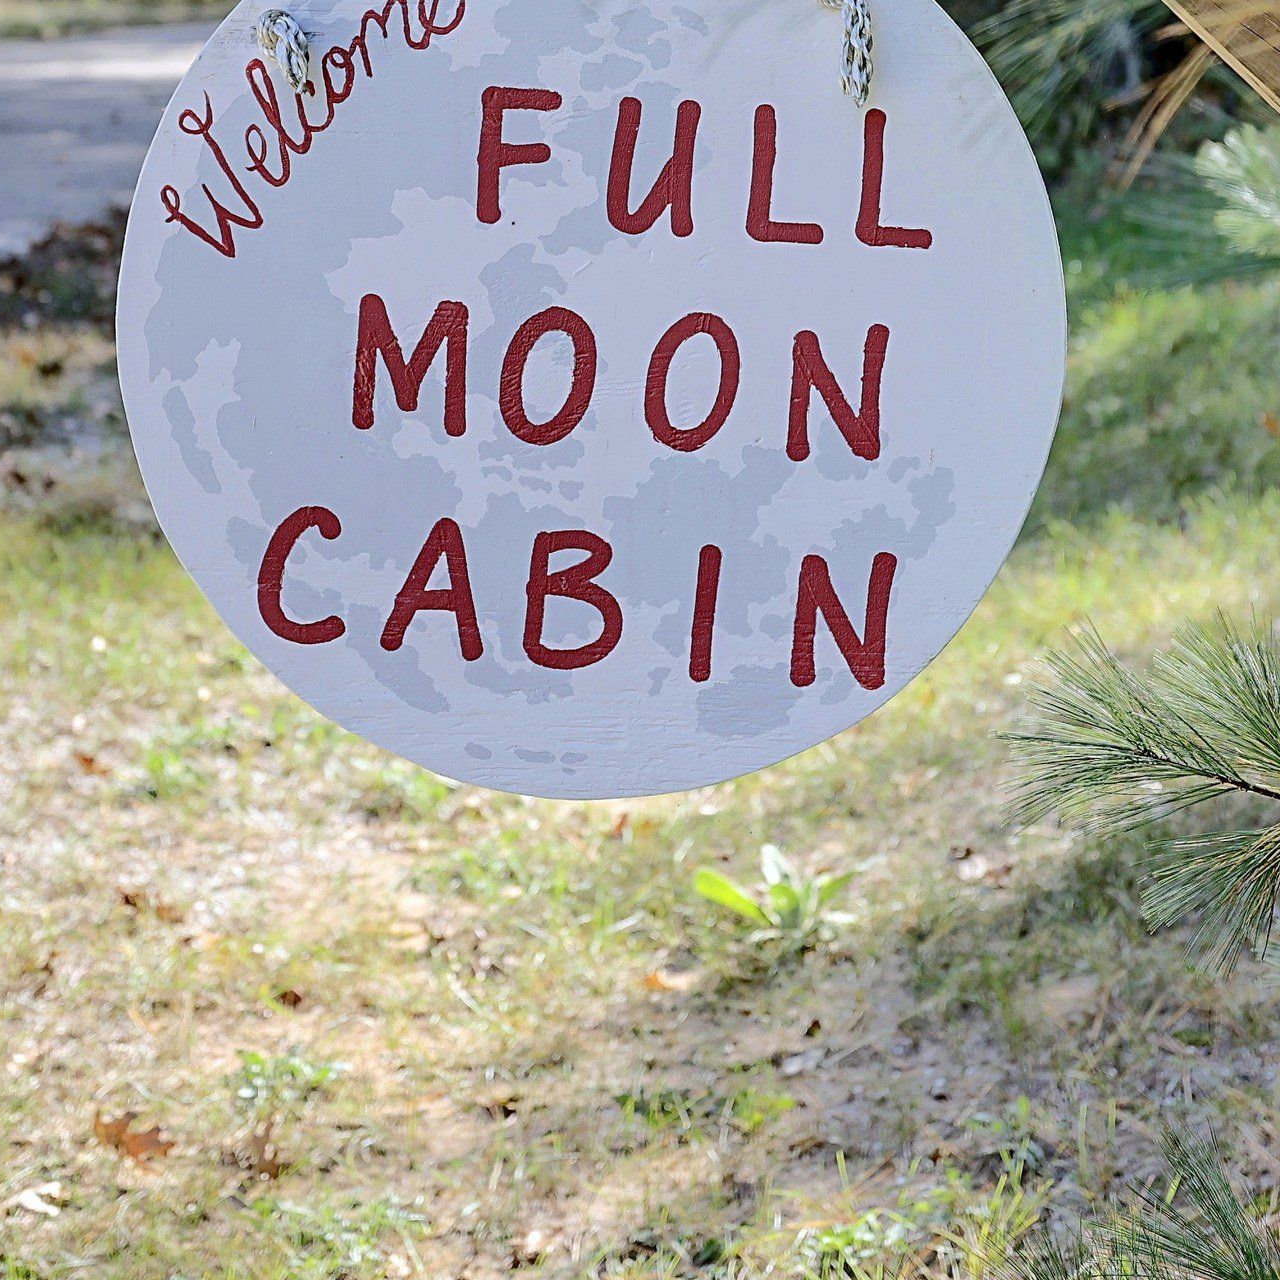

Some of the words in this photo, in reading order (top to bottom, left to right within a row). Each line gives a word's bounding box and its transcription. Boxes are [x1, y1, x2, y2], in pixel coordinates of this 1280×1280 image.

[476, 86, 933, 249] FULL
[352, 293, 890, 462] MOON
[257, 505, 898, 691] CABIN
